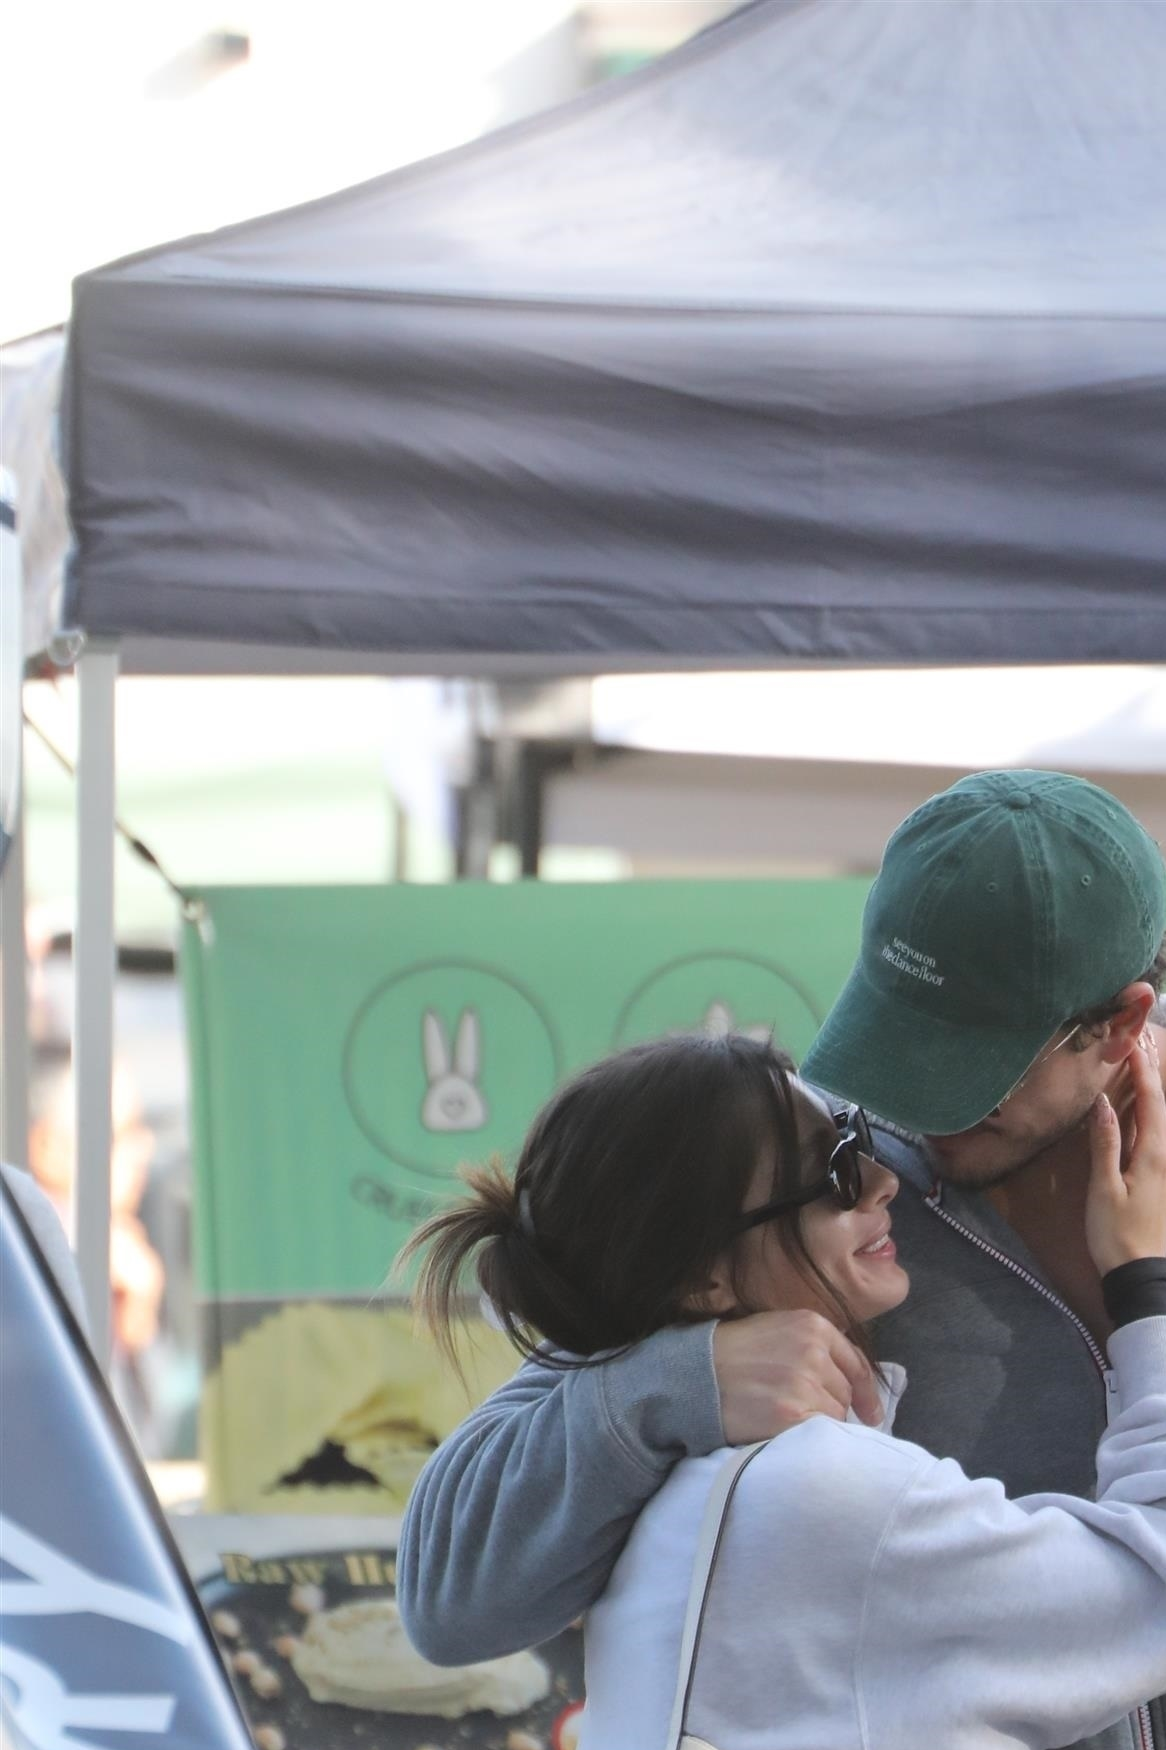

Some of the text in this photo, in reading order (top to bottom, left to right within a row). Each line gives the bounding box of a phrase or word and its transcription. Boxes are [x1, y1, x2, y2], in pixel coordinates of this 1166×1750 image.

[891, 951, 920, 977] dance
[918, 965, 944, 986] floor
[218, 1552, 326, 1586] Raw
